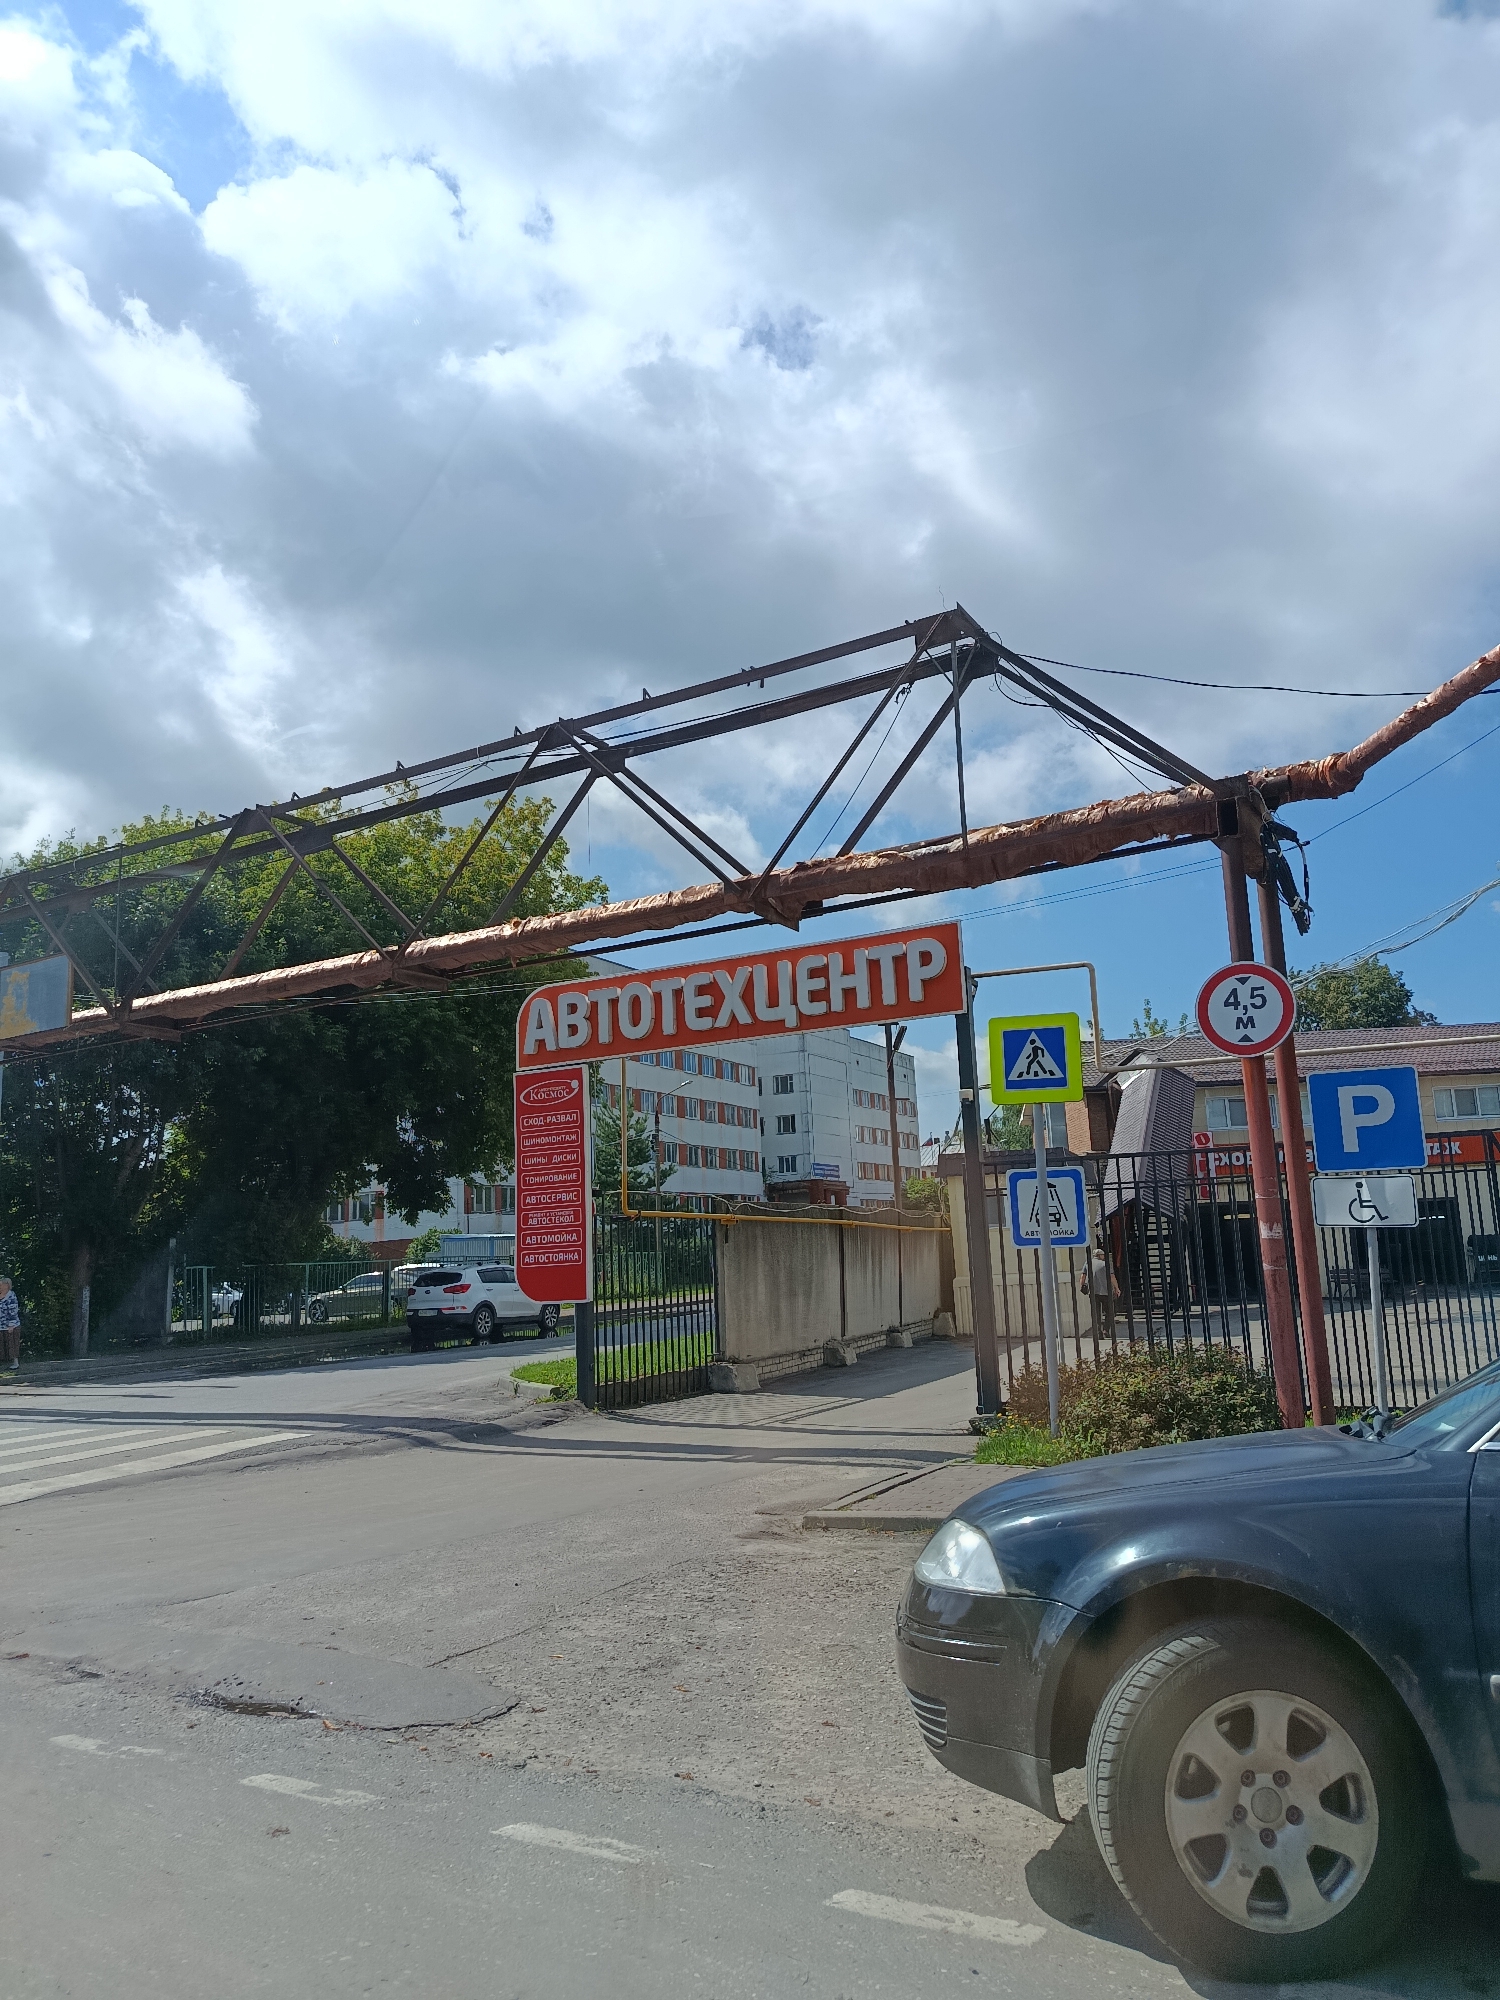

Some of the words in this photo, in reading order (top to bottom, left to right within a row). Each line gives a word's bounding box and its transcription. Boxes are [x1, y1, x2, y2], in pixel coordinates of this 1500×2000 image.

[523, 937, 948, 1055] АВТОТЕХЦЕНТР
[1223, 986, 1267, 1015] 4,5
[523, 1113, 577, 1126] СХОД-РАЗВАЛ
[1337, 1084, 1396, 1153] P
[523, 1134, 577, 1146] ШИНОМОНТАЖ
[524, 1155, 548, 1165] ШИНЫ
[551, 1153, 577, 1163] ДИСКИ
[525, 1173, 578, 1185] ТОНИРОВАНИЕ
[525, 1192, 578, 1205] АВТОСЕРВИС
[527, 1215, 574, 1226] АВТОСТЕКОЛ
[525, 1231, 578, 1245] АВТОМОЙКА
[1024, 1227, 1075, 1237] АВТОЙКА
[524, 1252, 579, 1264] АВТОСТОЯНКА
